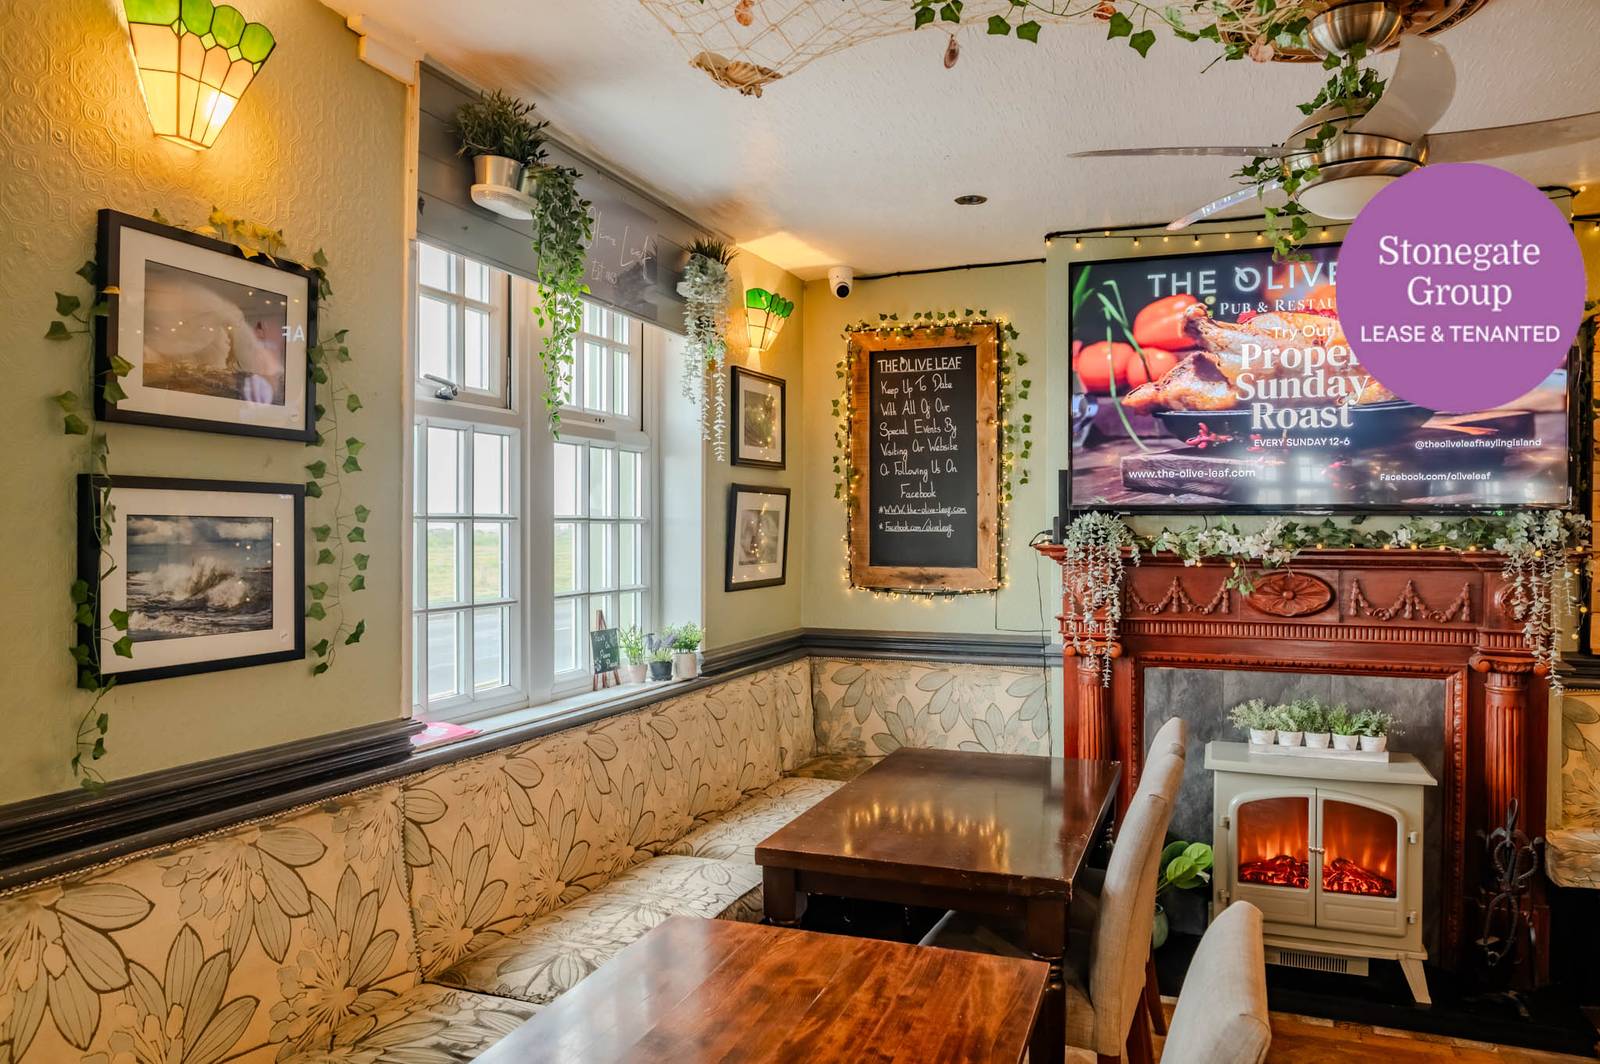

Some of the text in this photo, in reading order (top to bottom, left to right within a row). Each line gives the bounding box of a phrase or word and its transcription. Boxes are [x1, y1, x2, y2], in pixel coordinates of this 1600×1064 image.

[1147, 270, 1217, 298] THE
[1257, 300, 1269, 313] &
[1271, 324, 1335, 341] Try Our
[877, 356, 962, 373] THE OLIVE LEAF
[880, 373, 953, 399] Keep Up To Date
[1235, 369, 1370, 403] Sunday
[902, 400, 916, 415] All
[1251, 402, 1354, 430] Roast
[879, 417, 957, 441] Special Events By
[880, 442, 908, 461] Visiting
[927, 436, 959, 452] Website
[1254, 437, 1351, 448] EVERY SUNDAY 12-6
[894, 461, 928, 483] Following
[931, 459, 941, 474] Us
[945, 458, 958, 473] On
[1128, 467, 1257, 479] www.the-olive-leaf.com
[900, 481, 937, 499] Facebook
